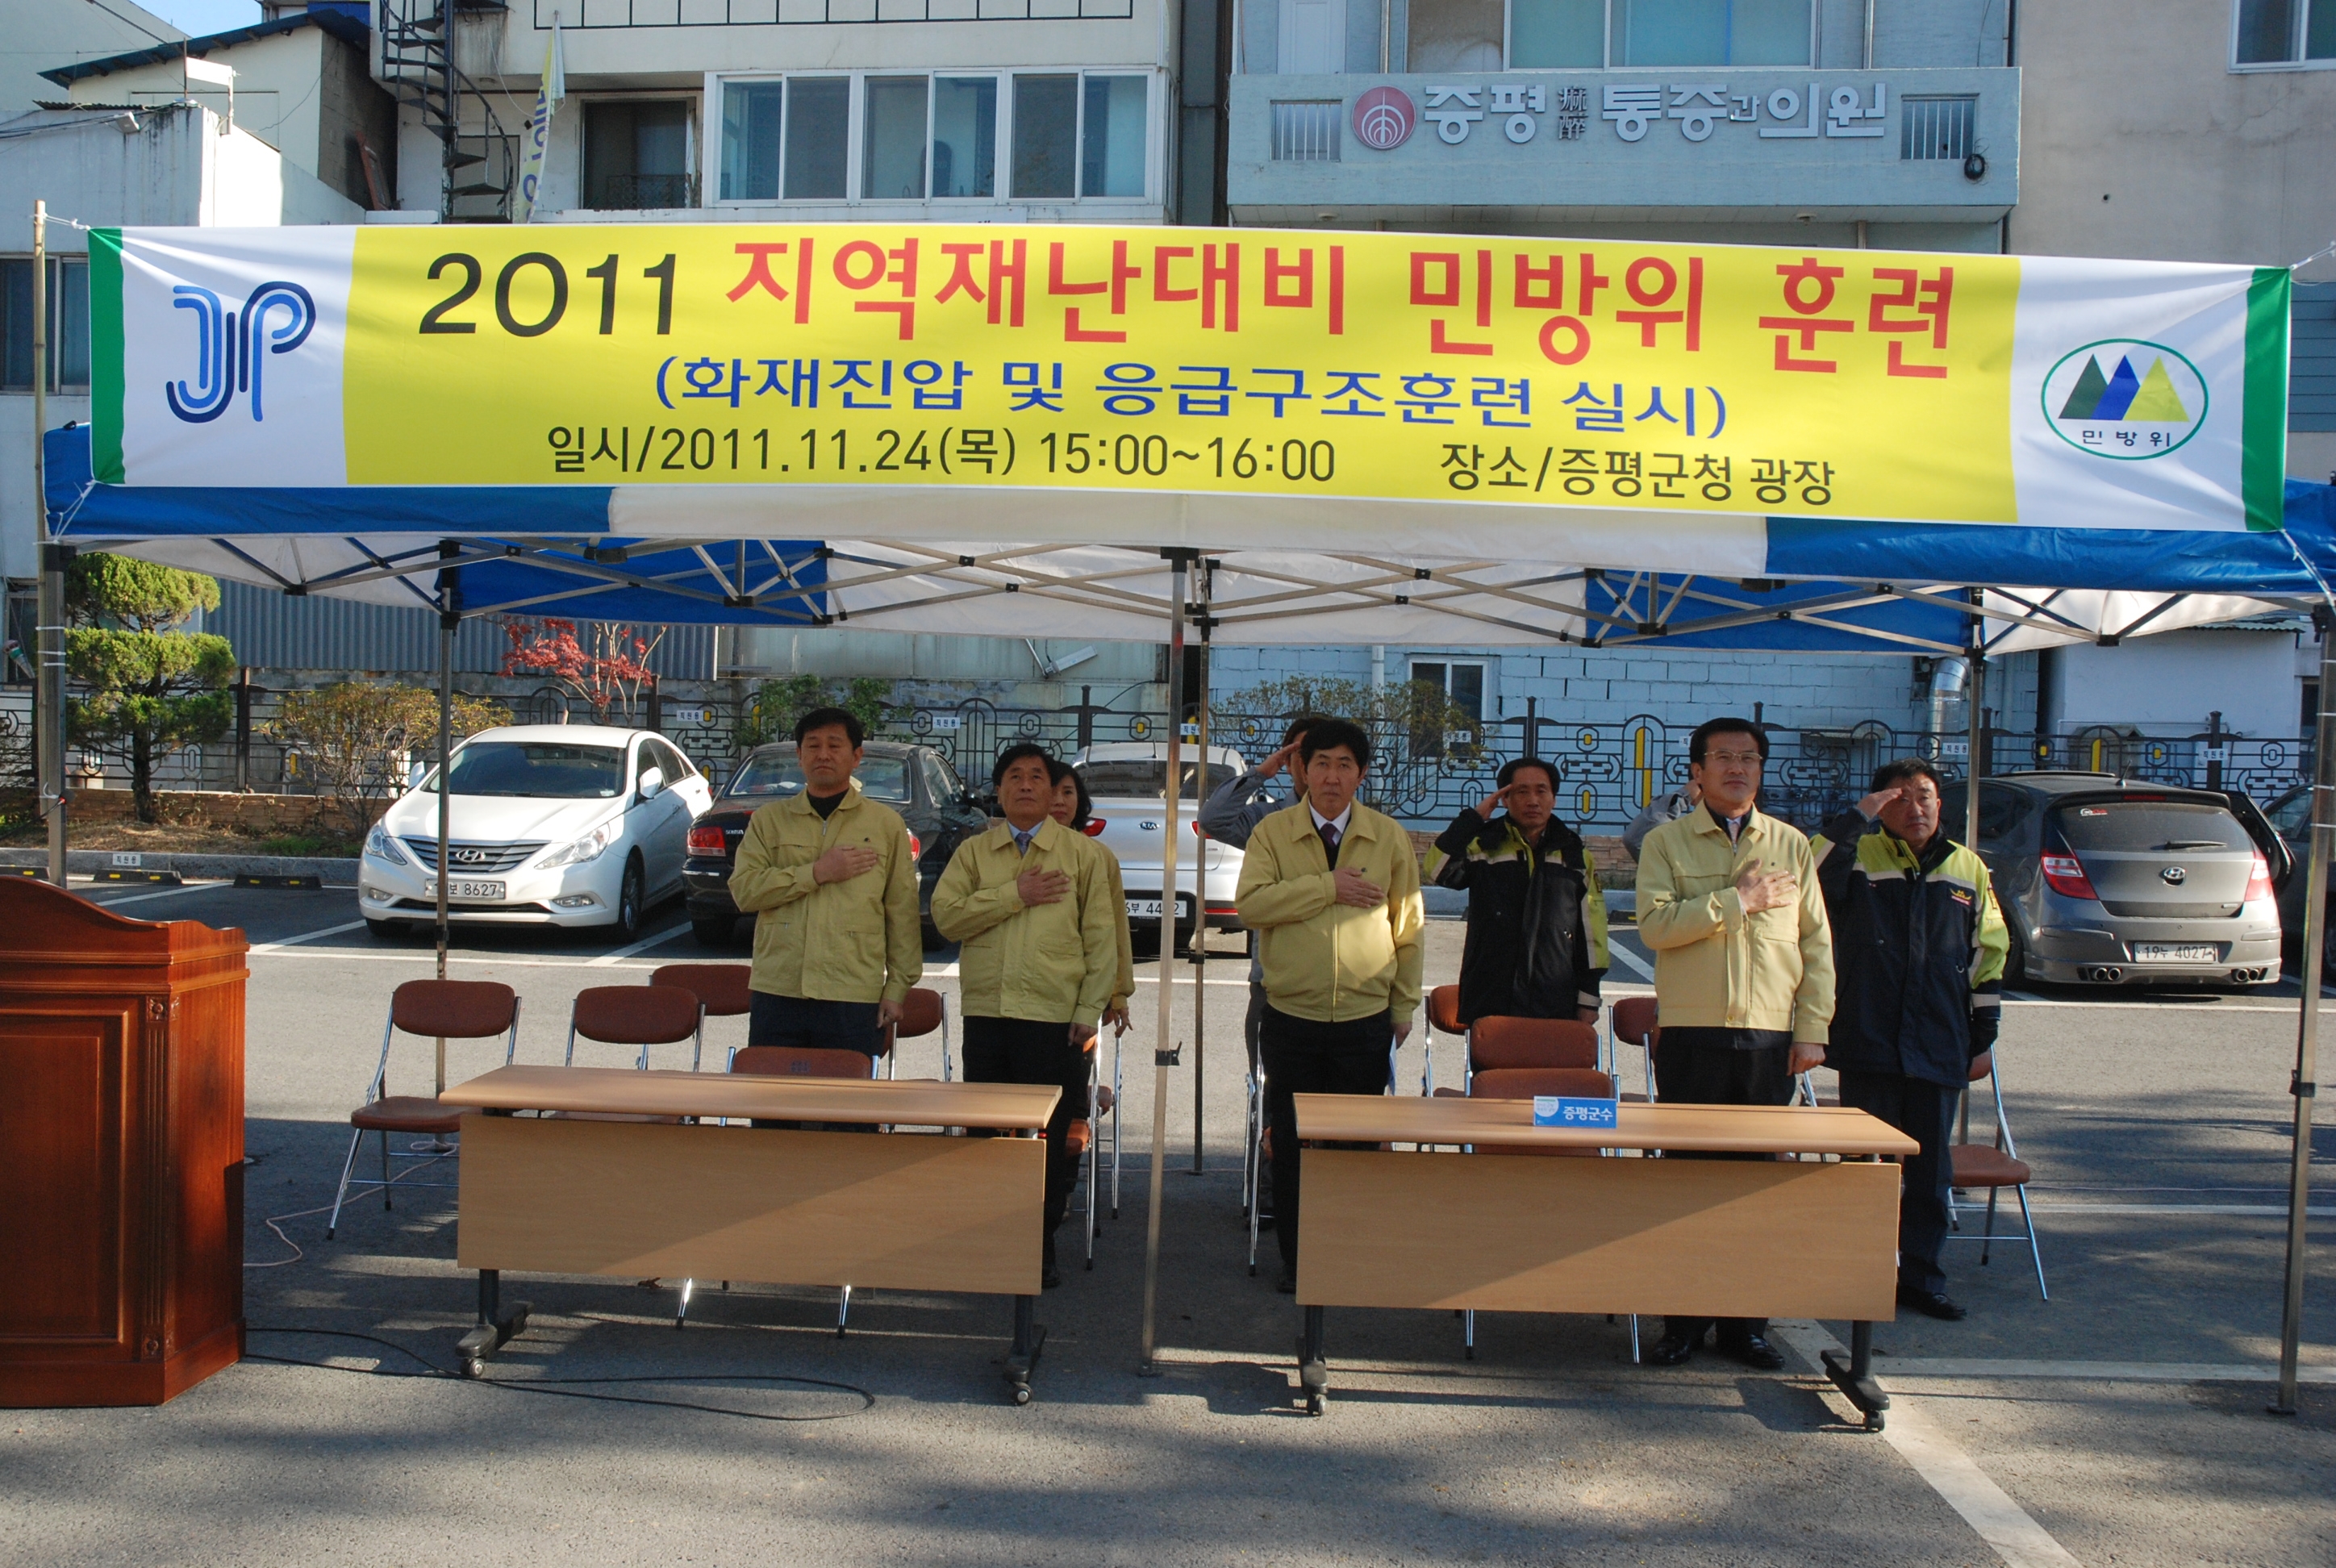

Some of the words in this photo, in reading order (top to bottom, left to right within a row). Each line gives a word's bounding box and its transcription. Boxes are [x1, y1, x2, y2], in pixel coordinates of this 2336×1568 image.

[1425, 84, 1546, 144] 증평
[419, 252, 676, 337] 2011
[726, 237, 1345, 344] 지역재난대비
[1409, 249, 1704, 366] 민방위
[1758, 257, 1954, 379] 훈련
[656, 356, 974, 411] (화재진압
[1003, 361, 1066, 412] 및
[1095, 362, 1532, 428] 응급구조훈련
[1562, 382, 1726, 439] 실시)
[547, 425, 1016, 475] 일시/2011.11.24(목)
[1041, 432, 1335, 482] 15:00~16:00
[1441, 443, 1733, 502] 장소/증평군청
[1750, 459, 1835, 507] 광장
[464, 883, 498, 896] 8627
[1145, 902, 1179, 915] 442
[2175, 946, 2209, 959] 4027
[1562, 1106, 1613, 1121] 증평군수
